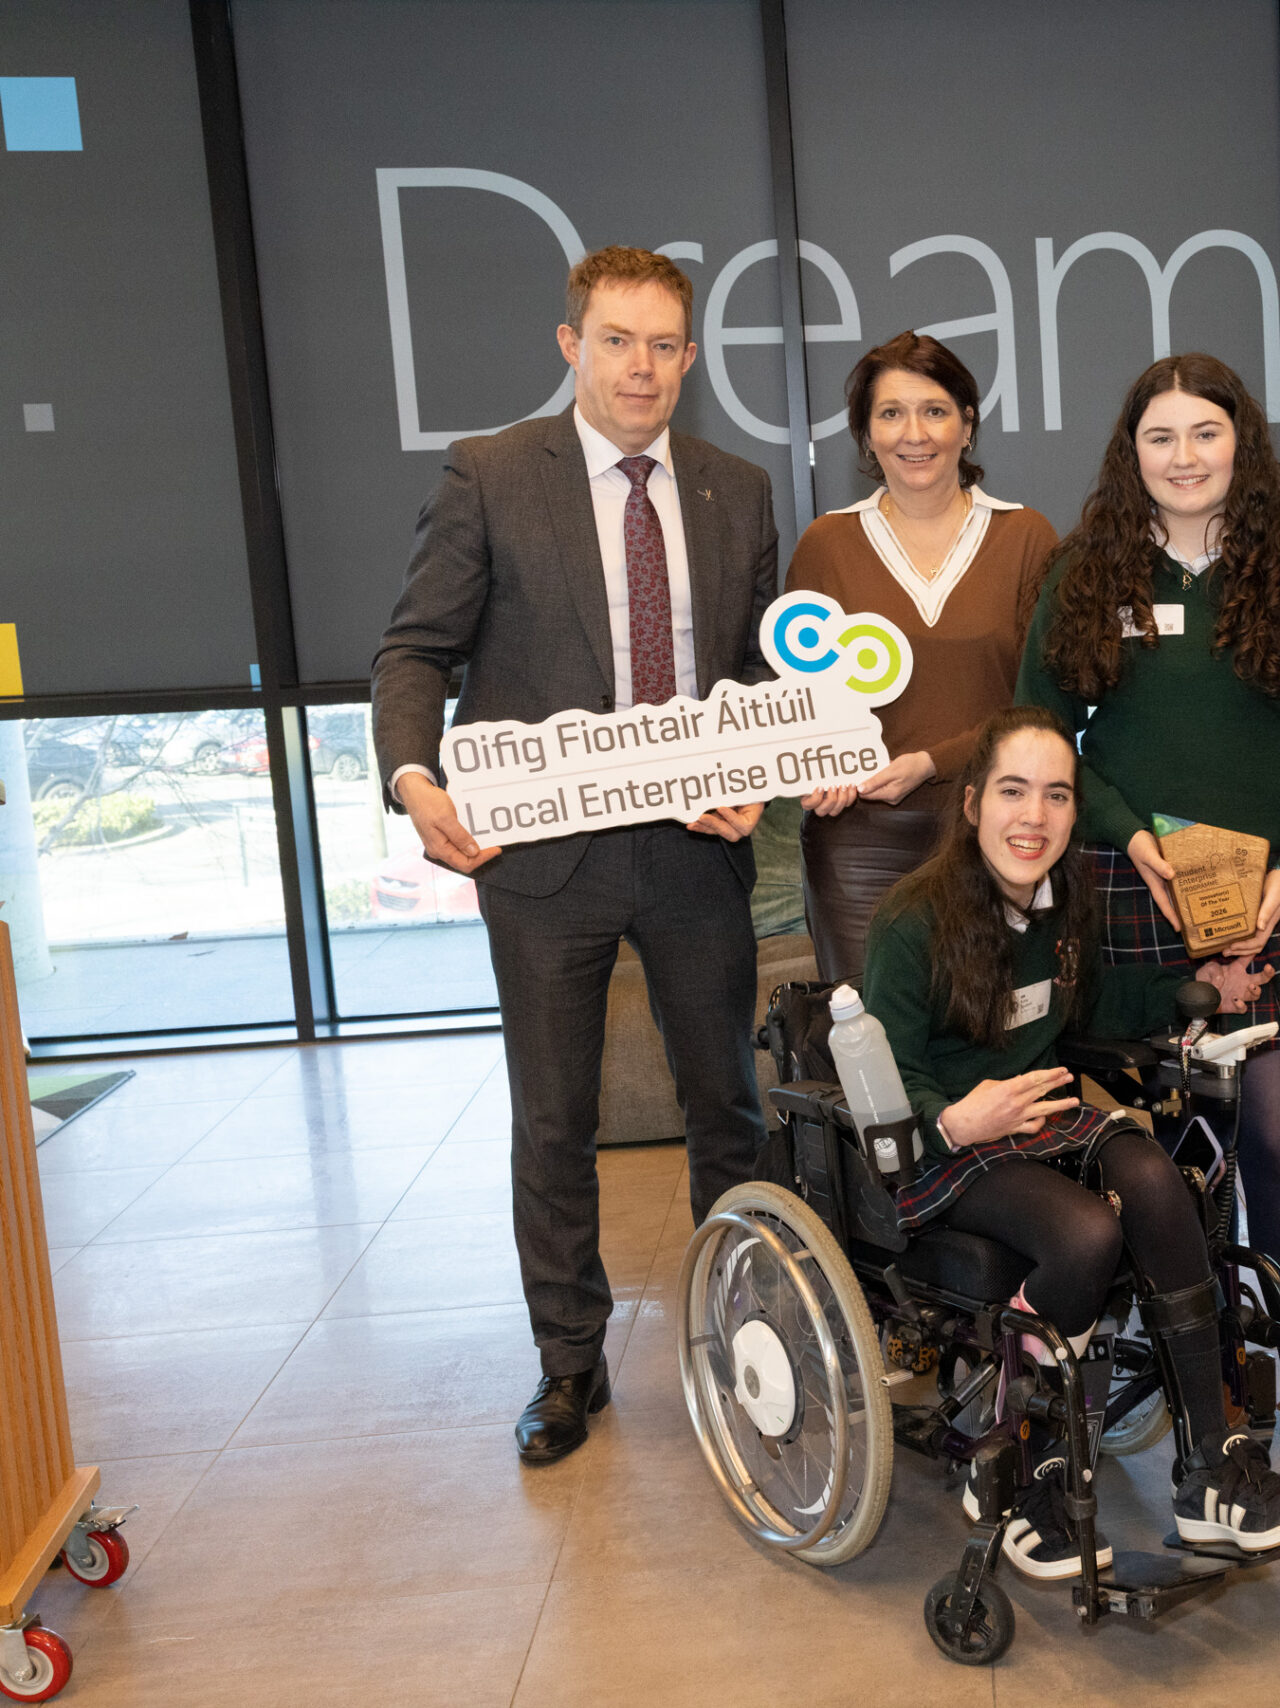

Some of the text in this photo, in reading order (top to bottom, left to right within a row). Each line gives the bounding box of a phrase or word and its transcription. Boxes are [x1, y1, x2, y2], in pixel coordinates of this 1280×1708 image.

[452, 686, 817, 774] Oifig Fiontair Áitiúil
[465, 745, 879, 837] Local Enterprise Office
[1176, 866, 1206, 879] Student
[1178, 872, 1216, 886] Enterprise
[1210, 908, 1228, 917] 2026
[1214, 922, 1242, 933] Microsoft
